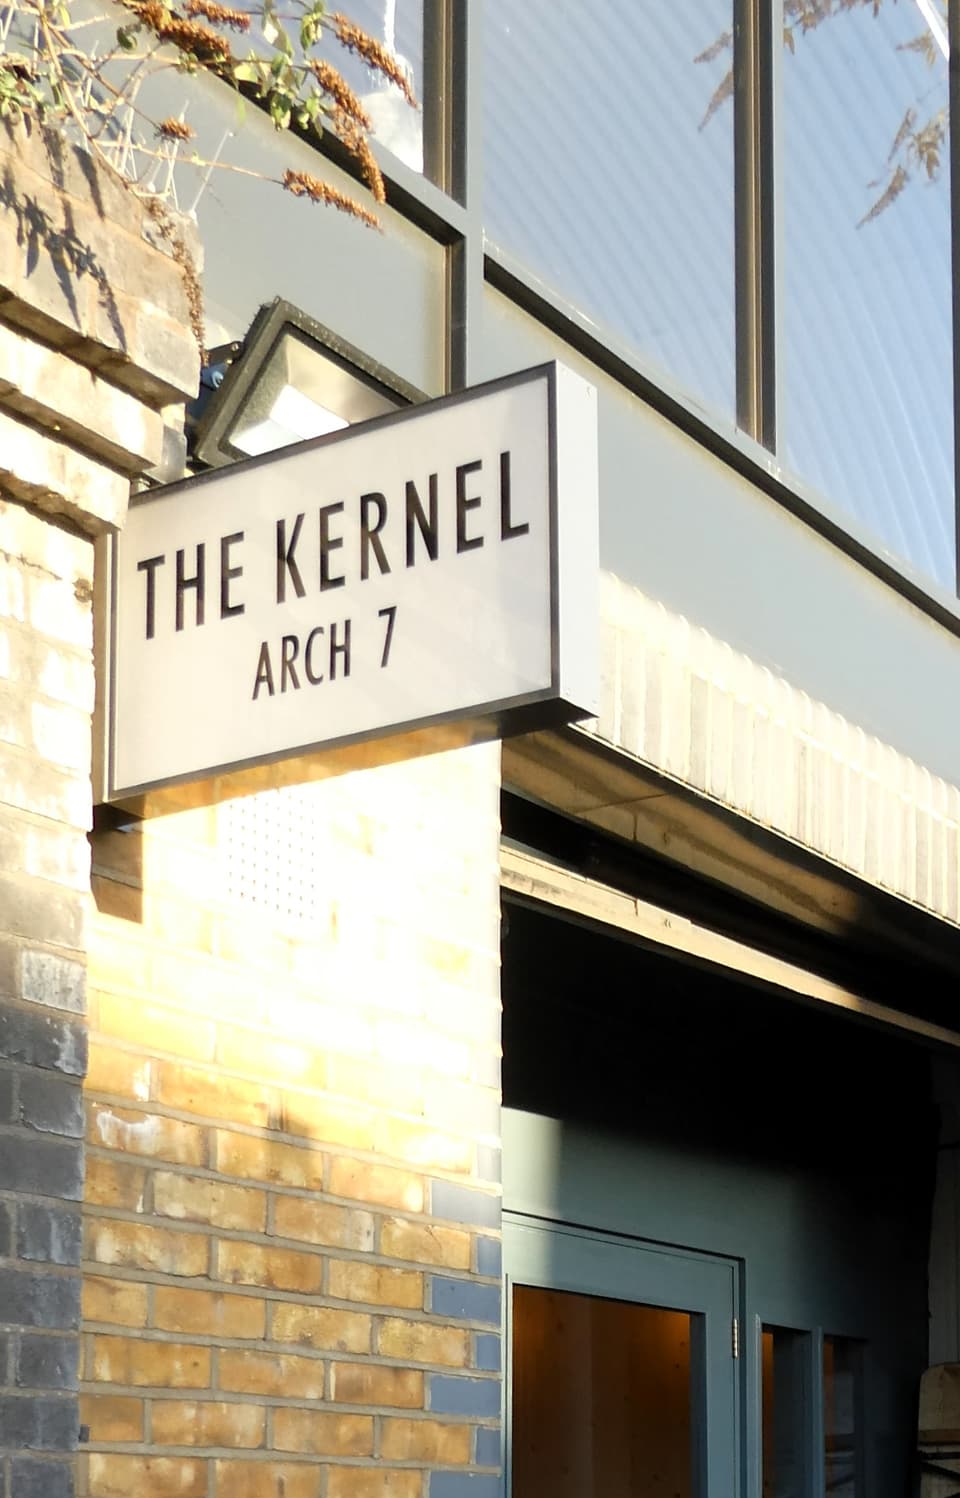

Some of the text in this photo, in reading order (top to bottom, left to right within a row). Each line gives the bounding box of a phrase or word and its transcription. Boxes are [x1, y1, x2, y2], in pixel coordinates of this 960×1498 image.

[137, 450, 530, 640] THE KERNEL
[252, 606, 397, 700] ARCH 7
